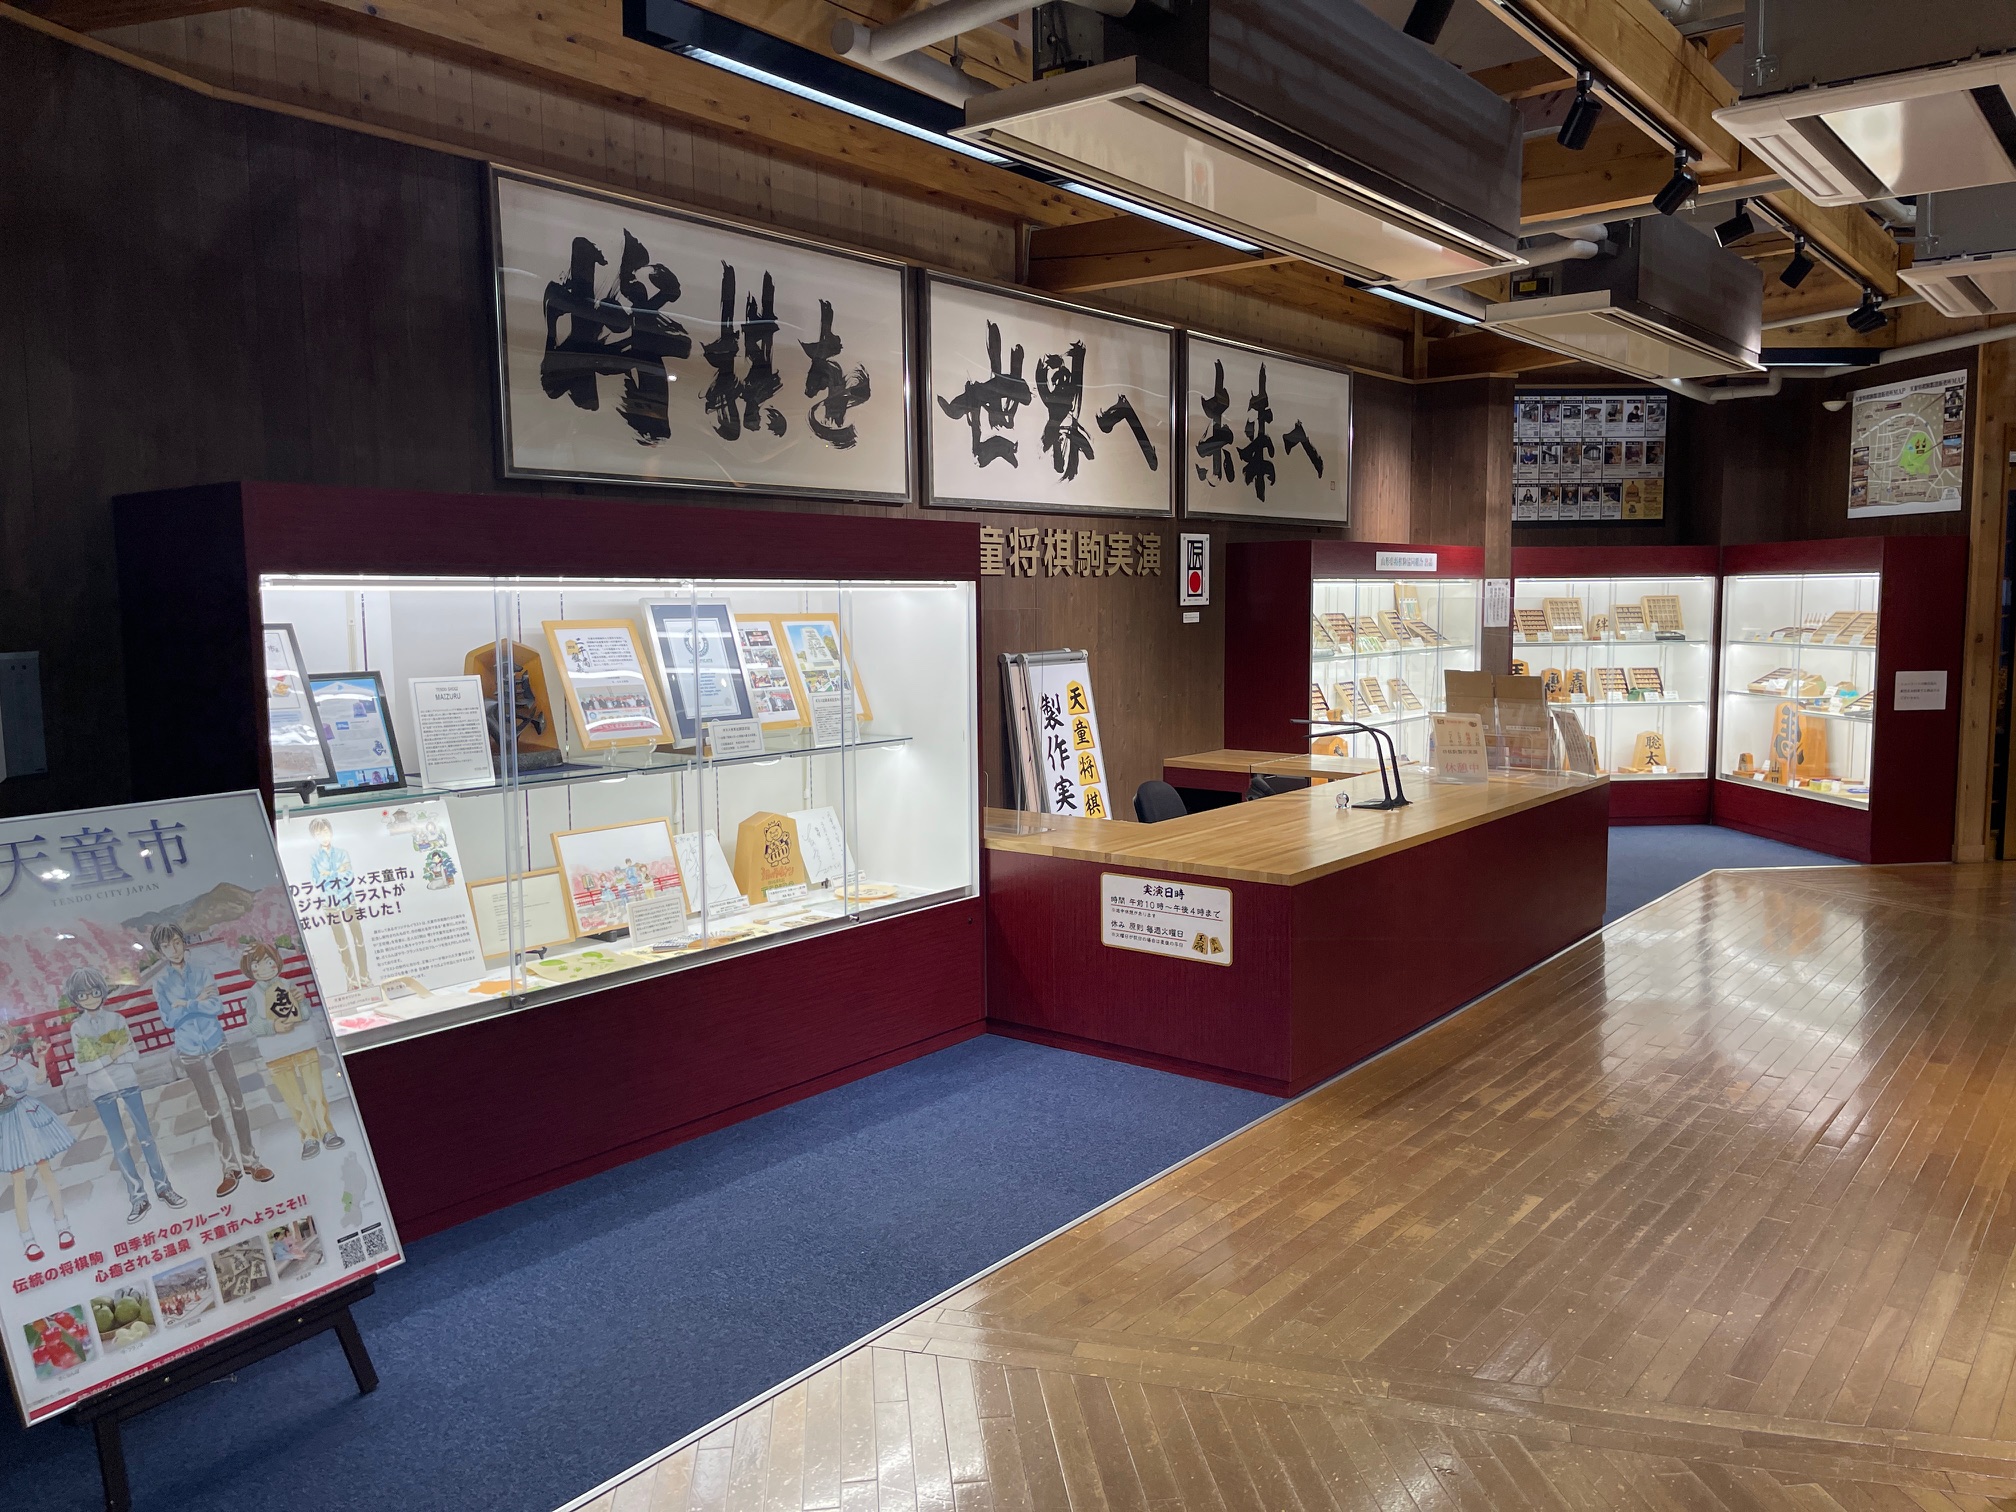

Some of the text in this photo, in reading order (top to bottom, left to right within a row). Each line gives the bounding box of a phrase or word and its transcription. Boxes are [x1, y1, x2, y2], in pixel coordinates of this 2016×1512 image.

[937, 319, 1159, 483] 世界へ
[1039, 692, 1078, 816] 製作実
[1445, 762, 1479, 773] 休憩中
[0, 819, 188, 897] 天童市
[51, 882, 161, 907] TENDO CITY JAPAN
[298, 883, 406, 913] ジナルイラストが
[1111, 896, 1126, 905] 時間
[1143, 884, 1185, 900] 実演日時
[1111, 920, 1184, 938] 休み 原則 毎週火曜日
[12, 1204, 233, 1294] 伝統の将棋駒 四季折々のフルーツ
[94, 1238, 191, 1284] 心癒される温泉
